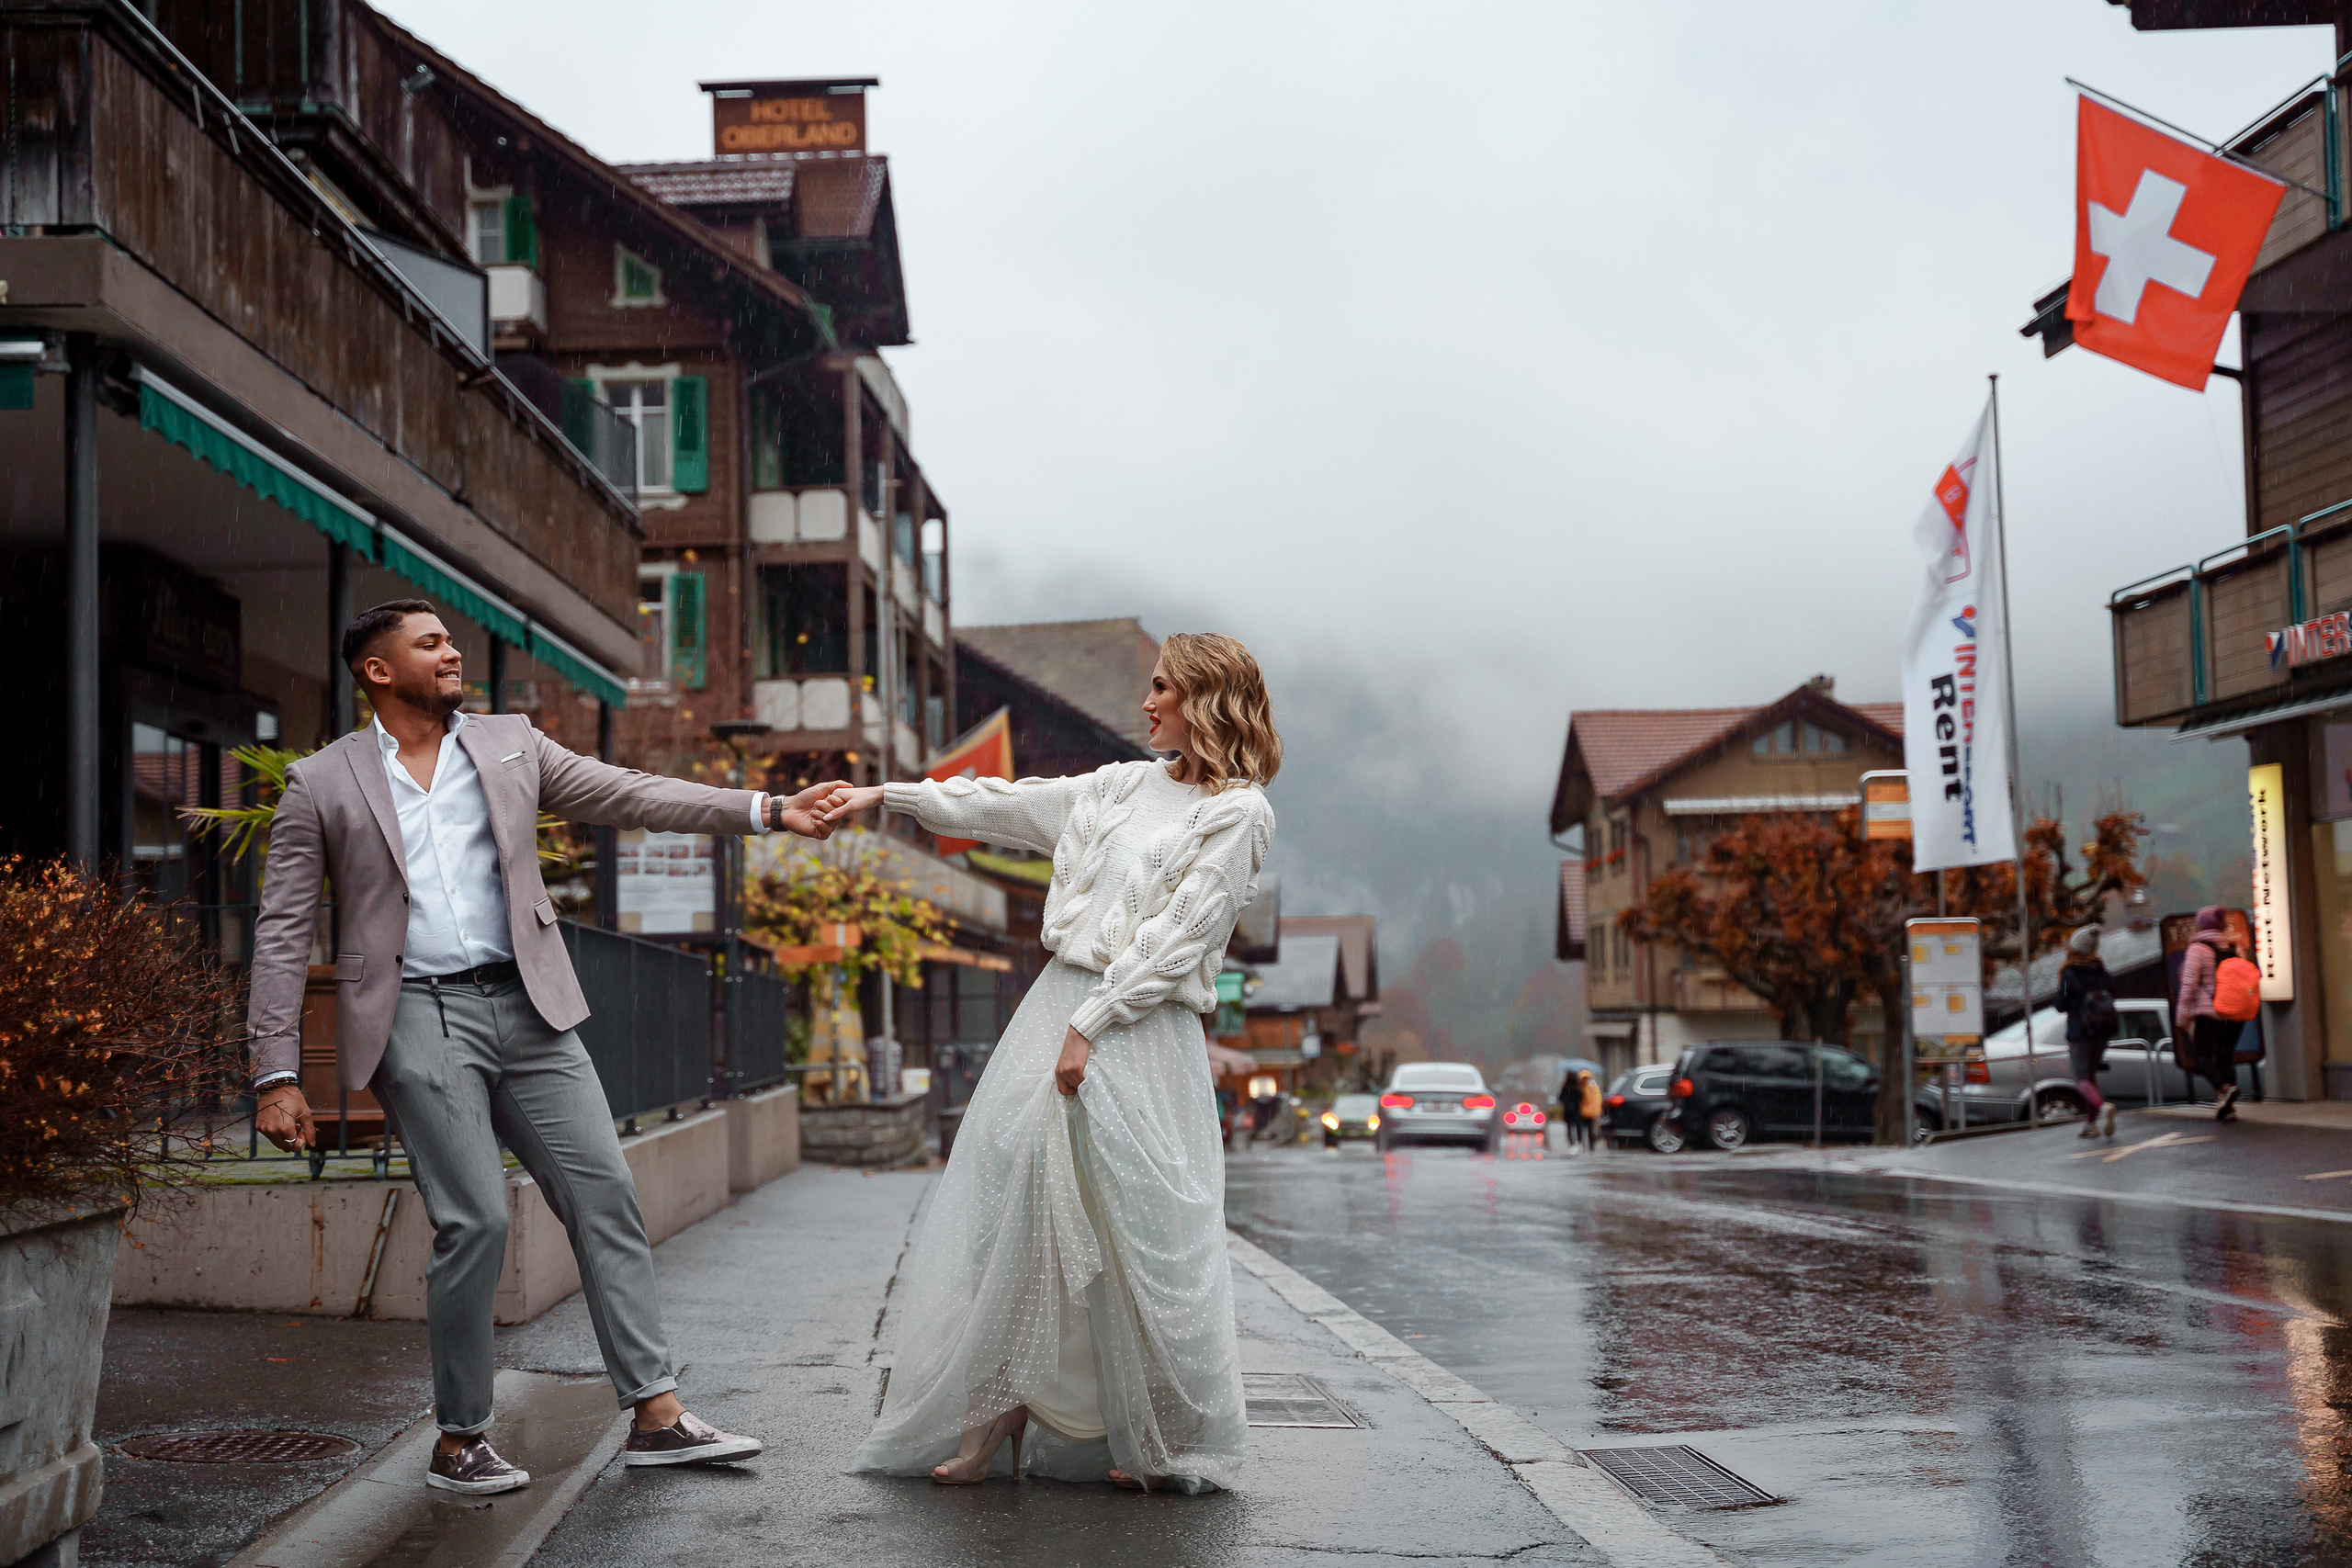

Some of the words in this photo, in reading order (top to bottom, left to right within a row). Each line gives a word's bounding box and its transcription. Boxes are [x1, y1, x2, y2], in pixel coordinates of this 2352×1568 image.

[751, 97, 833, 123] HOTEL
[2288, 609, 2352, 668] INTER
[1931, 673, 1962, 801] Rent
